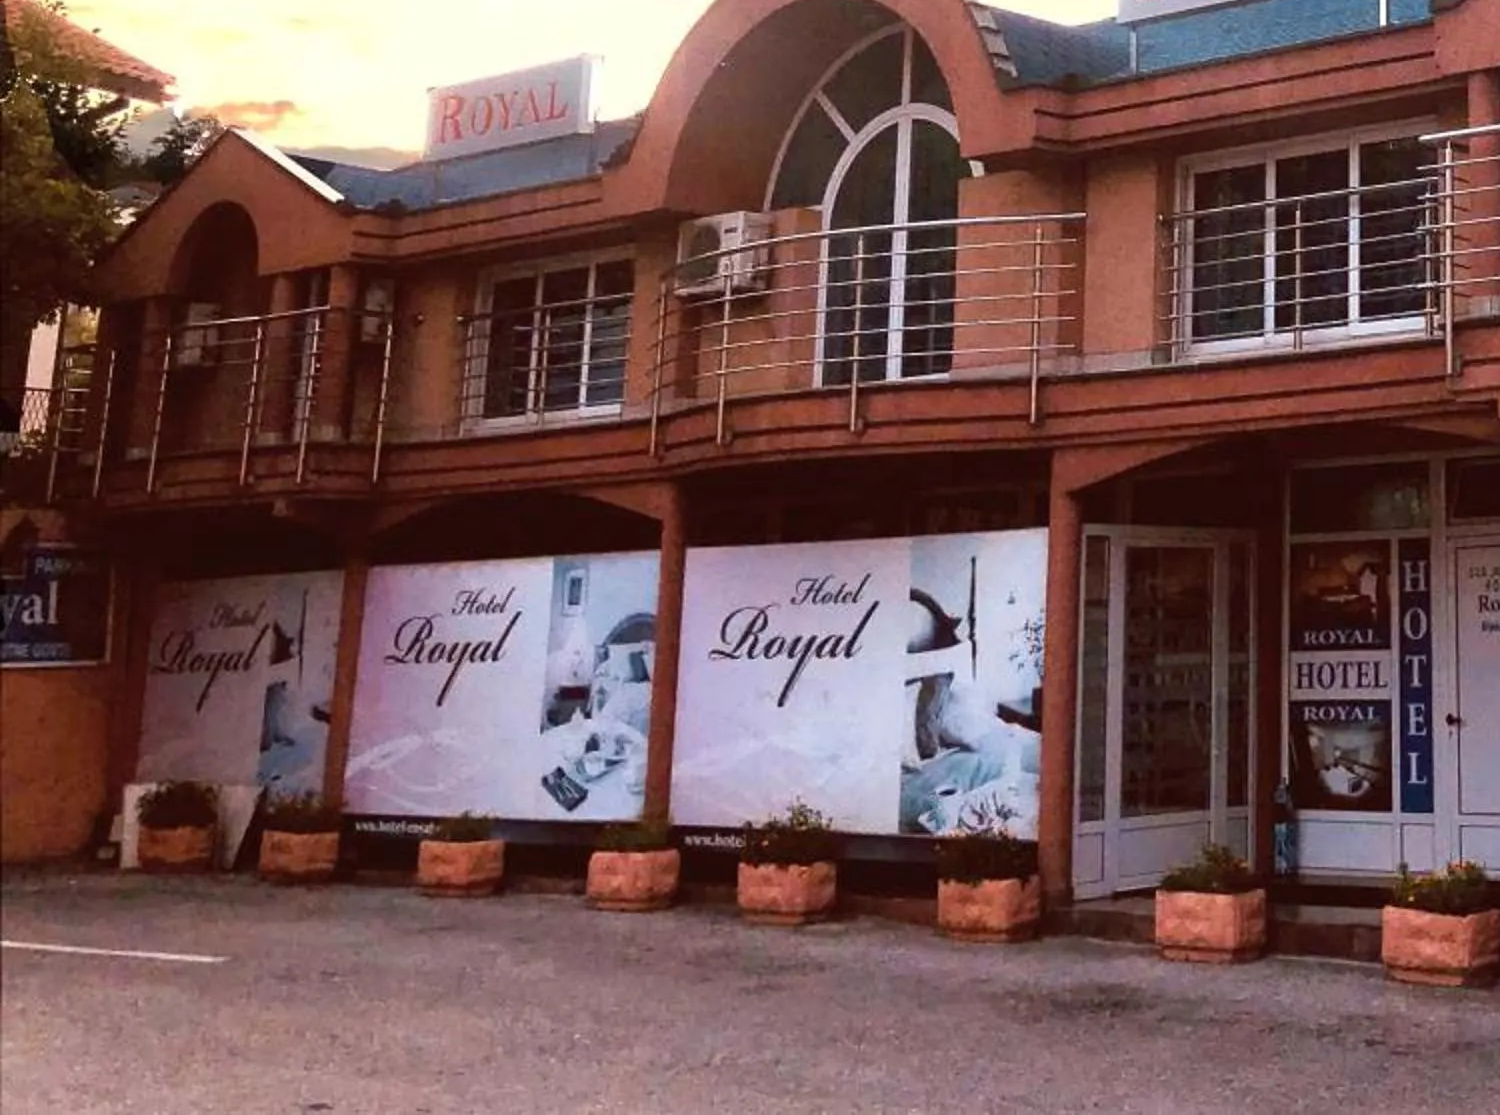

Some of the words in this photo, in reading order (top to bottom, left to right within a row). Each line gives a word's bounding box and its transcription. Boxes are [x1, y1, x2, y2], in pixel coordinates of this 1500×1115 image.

[438, 81, 569, 145] ROYAL
[0, 579, 59, 640] yal
[450, 587, 517, 616] Hotel
[790, 572, 872, 606] Hotel
[154, 622, 270, 712] Royal
[383, 610, 524, 707] Royal
[709, 600, 880, 708] Royal
[1303, 629, 1380, 645] ROYAL
[1296, 660, 1388, 690] HOTEL
[1403, 560, 1428, 785] HOTEL
[1303, 706, 1380, 722] ROYAL
